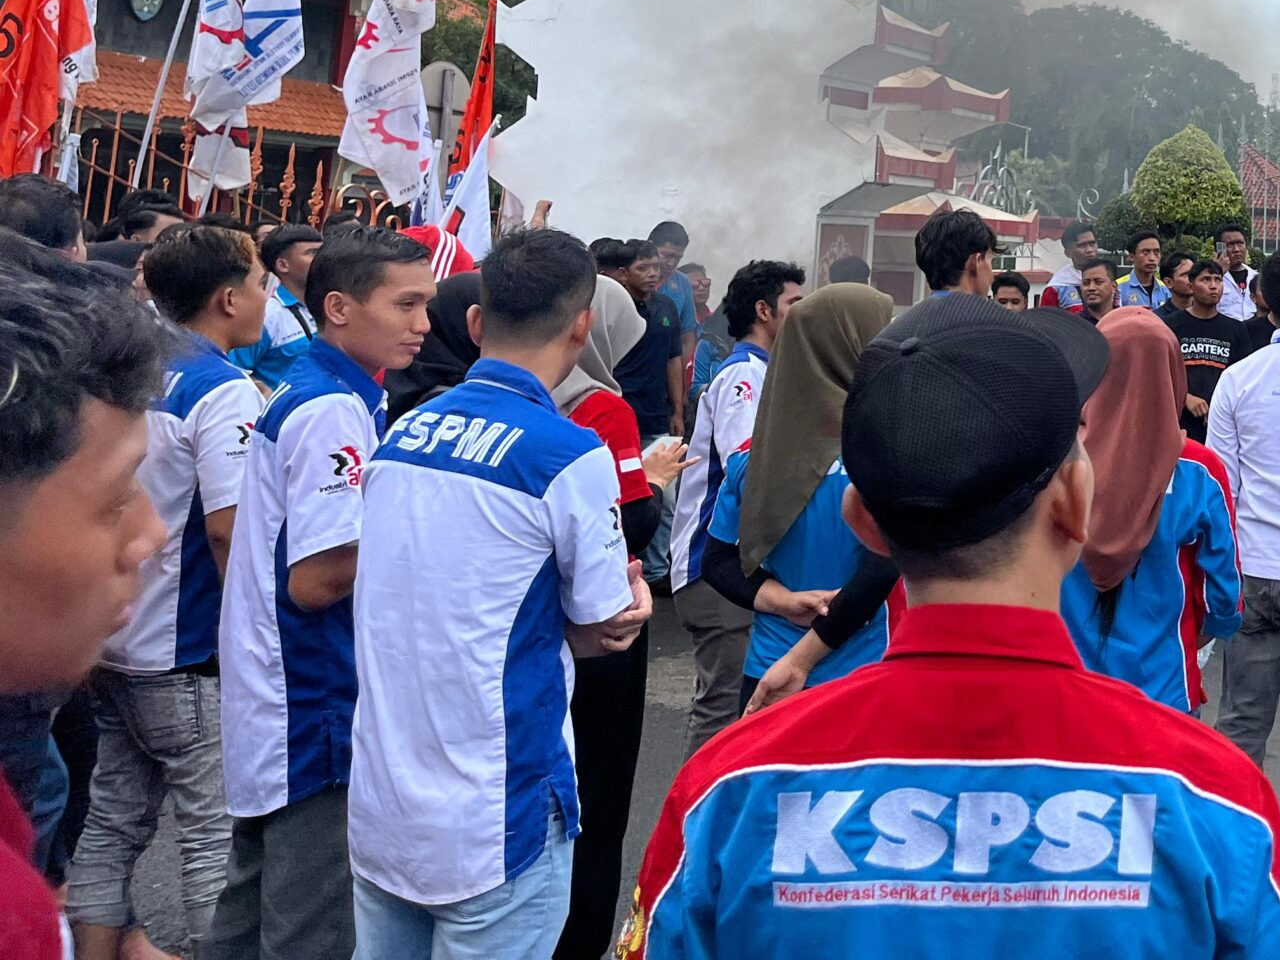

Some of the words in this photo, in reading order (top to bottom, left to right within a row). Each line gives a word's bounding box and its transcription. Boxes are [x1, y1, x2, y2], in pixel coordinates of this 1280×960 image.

[1180, 342, 1231, 358] GARTEKS
[380, 409, 525, 468] FSPMI
[771, 786, 1158, 876] KSPSI
[778, 883, 875, 904] Konfederasi
[879, 883, 937, 901] Serikat
[941, 886, 1000, 907] Pekerja
[1003, 887, 1061, 904] Seluruh
[1062, 885, 1140, 903] Indonesia
